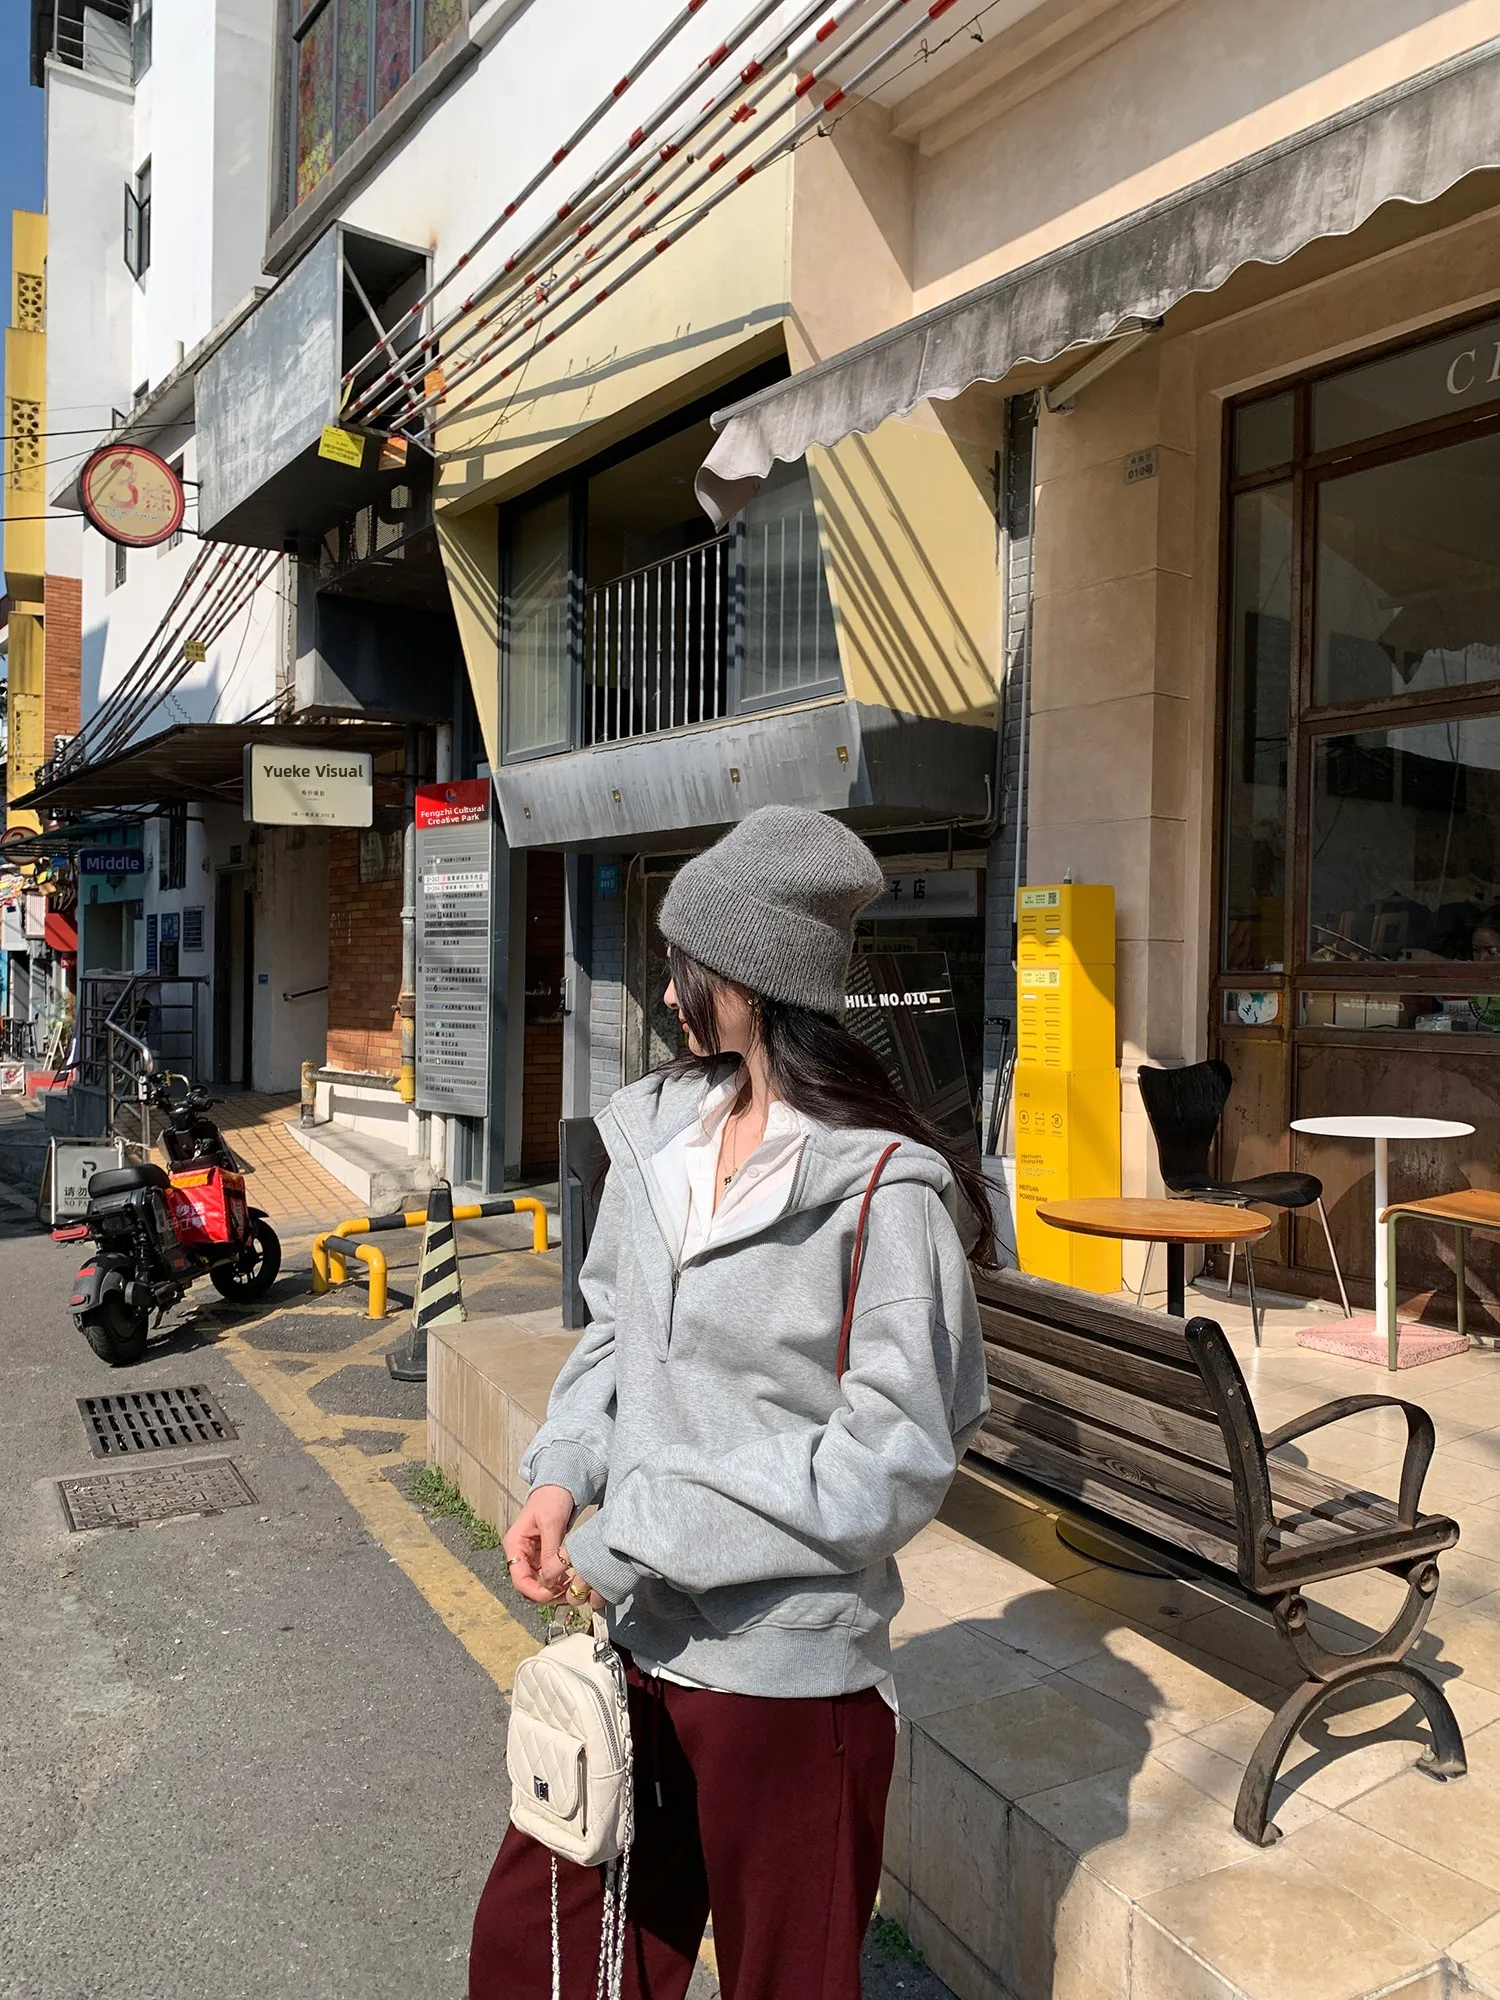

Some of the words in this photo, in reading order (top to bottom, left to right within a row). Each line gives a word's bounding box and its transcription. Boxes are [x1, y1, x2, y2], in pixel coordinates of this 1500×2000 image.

[263, 765, 311, 778] Yueke
[315, 764, 364, 778] Visual
[421, 807, 453, 818] Fengzhi
[453, 804, 485, 814] Cultural
[427, 815, 460, 825] Creative
[461, 813, 480, 822] Park
[86, 856, 140, 870] Middle
[879, 992, 928, 1007] NO.010
[1019, 1192, 1035, 1201] POWER
